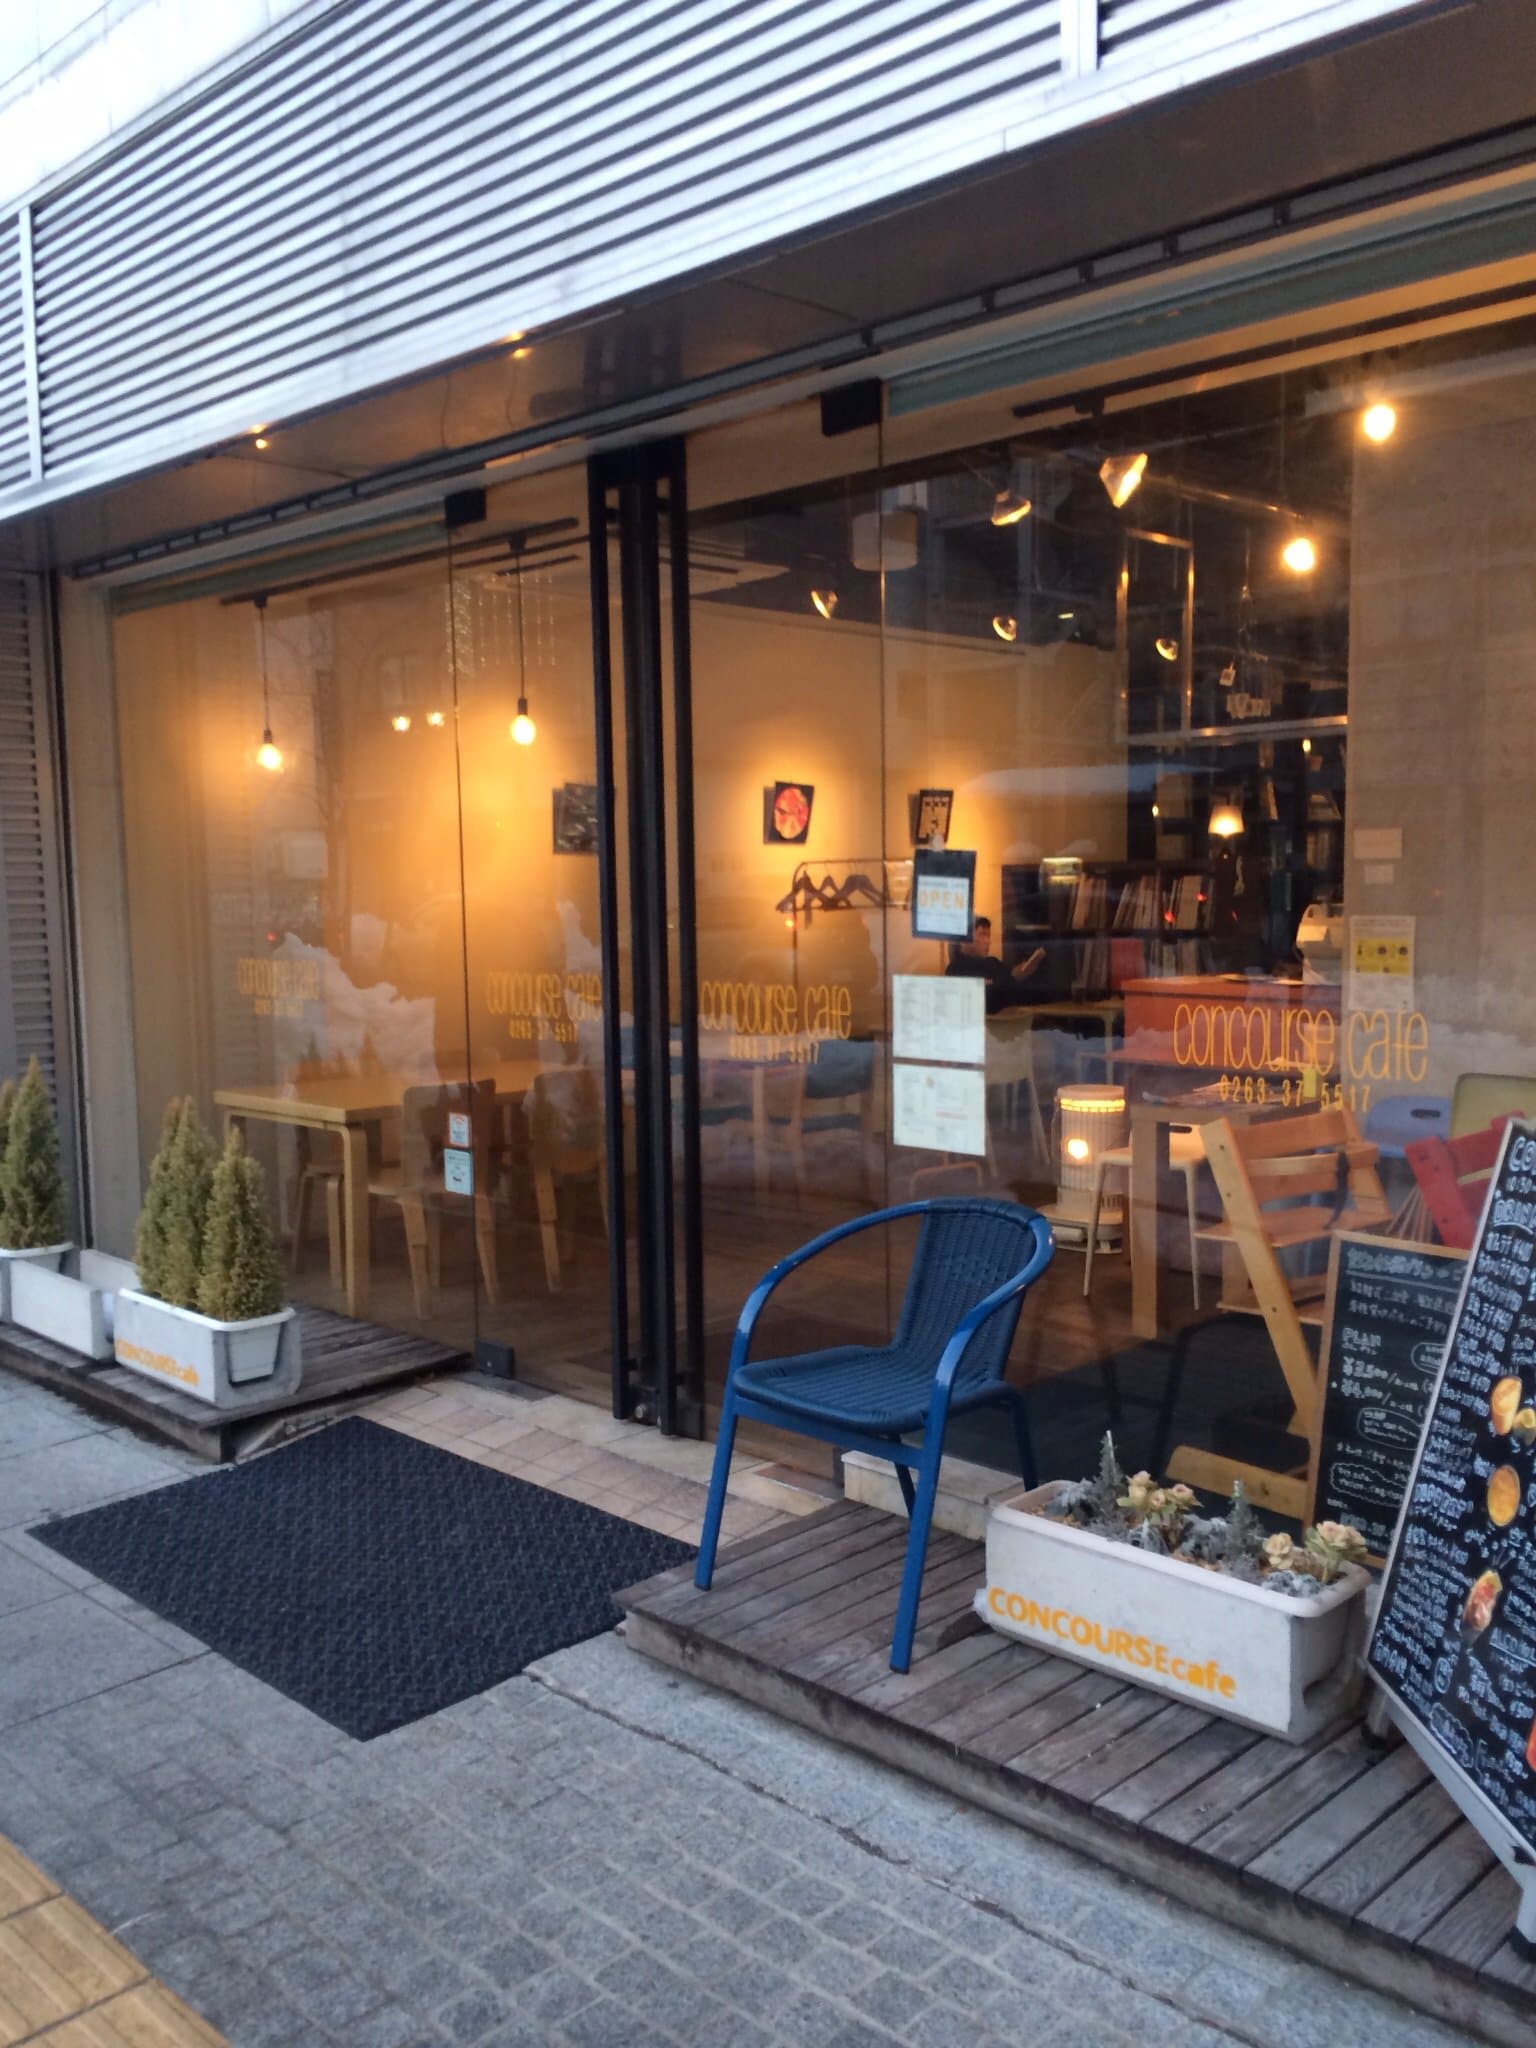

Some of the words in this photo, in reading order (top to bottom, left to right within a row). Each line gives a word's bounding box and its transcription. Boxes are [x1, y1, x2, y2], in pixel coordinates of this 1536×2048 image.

[702, 981, 797, 1036] concourse
[805, 985, 851, 1040] cafe
[1173, 1004, 1334, 1075] concourse
[1348, 1010, 1428, 1081] cafe
[1220, 1074, 1265, 1104] 0263
[1282, 1080, 1304, 1107] 37
[1321, 1083, 1370, 1112] 5517
[1508, 1135, 1536, 1173] CO
